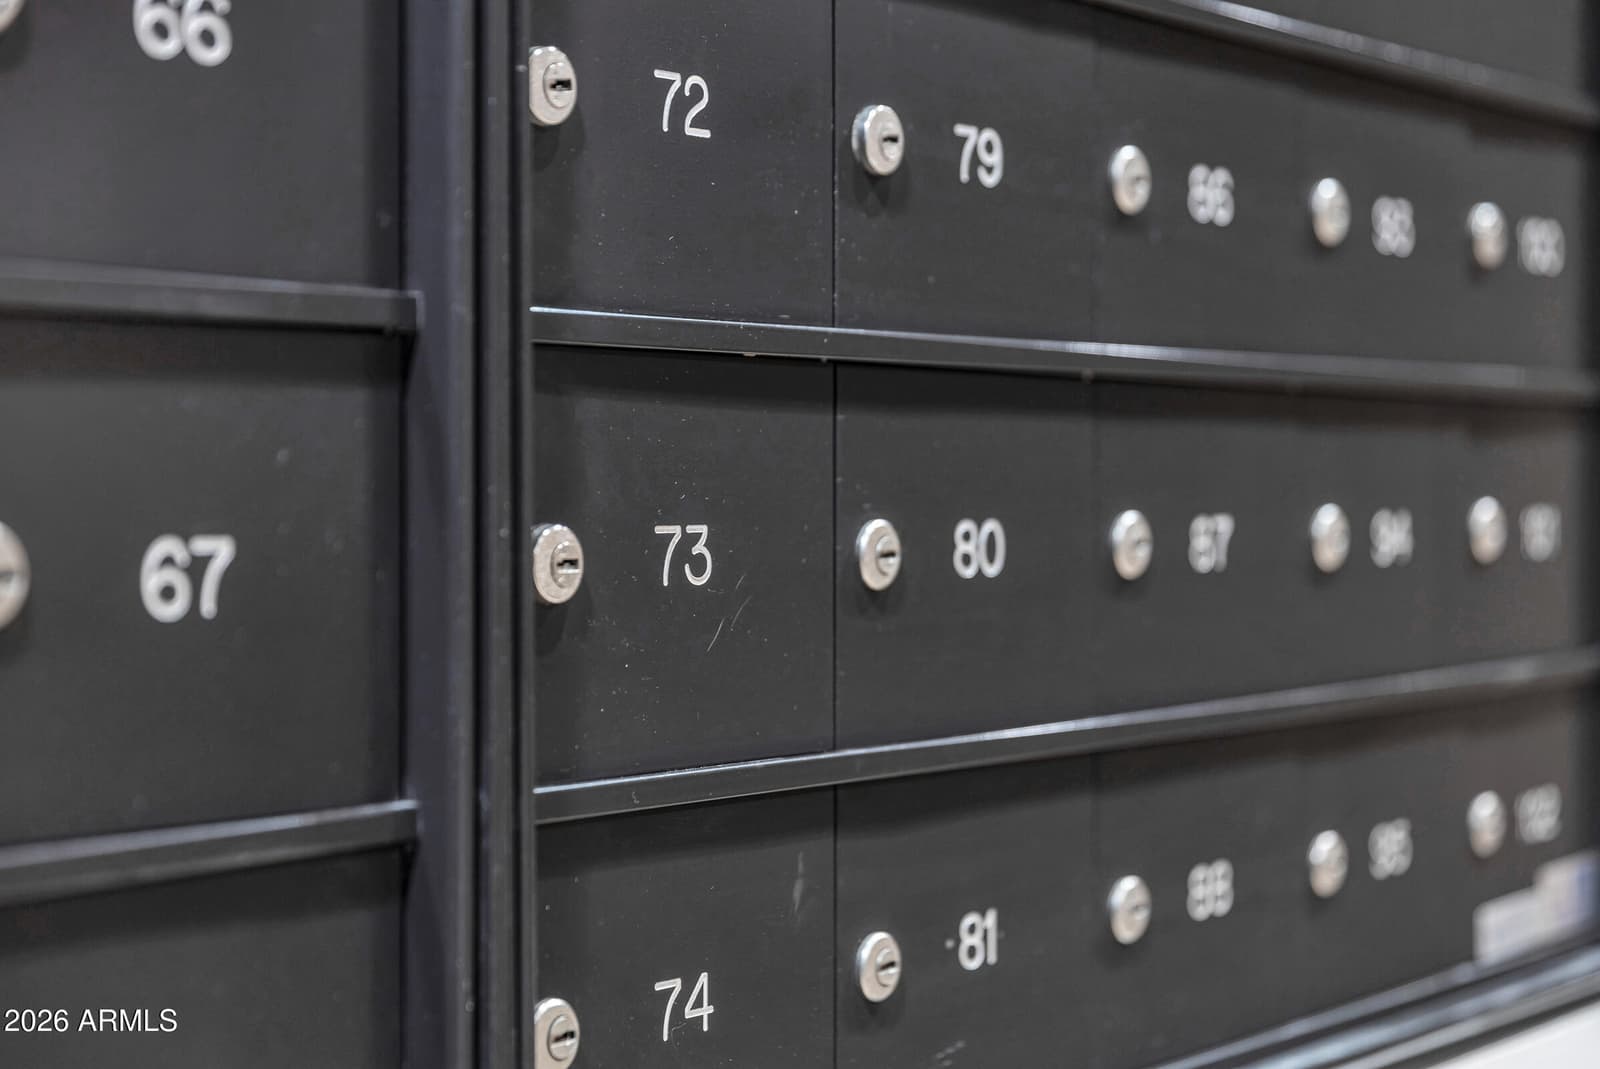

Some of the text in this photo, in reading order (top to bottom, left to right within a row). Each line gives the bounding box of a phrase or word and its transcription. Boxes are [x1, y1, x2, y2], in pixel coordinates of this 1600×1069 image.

[135, 0, 232, 67] 66
[654, 69, 711, 138] 72
[953, 123, 1004, 188] 79
[654, 524, 712, 587] 73
[953, 518, 1006, 579] 80
[1188, 512, 1235, 574] 87
[140, 535, 236, 623] 67
[958, 908, 998, 971] 81
[654, 971, 714, 1042] 74
